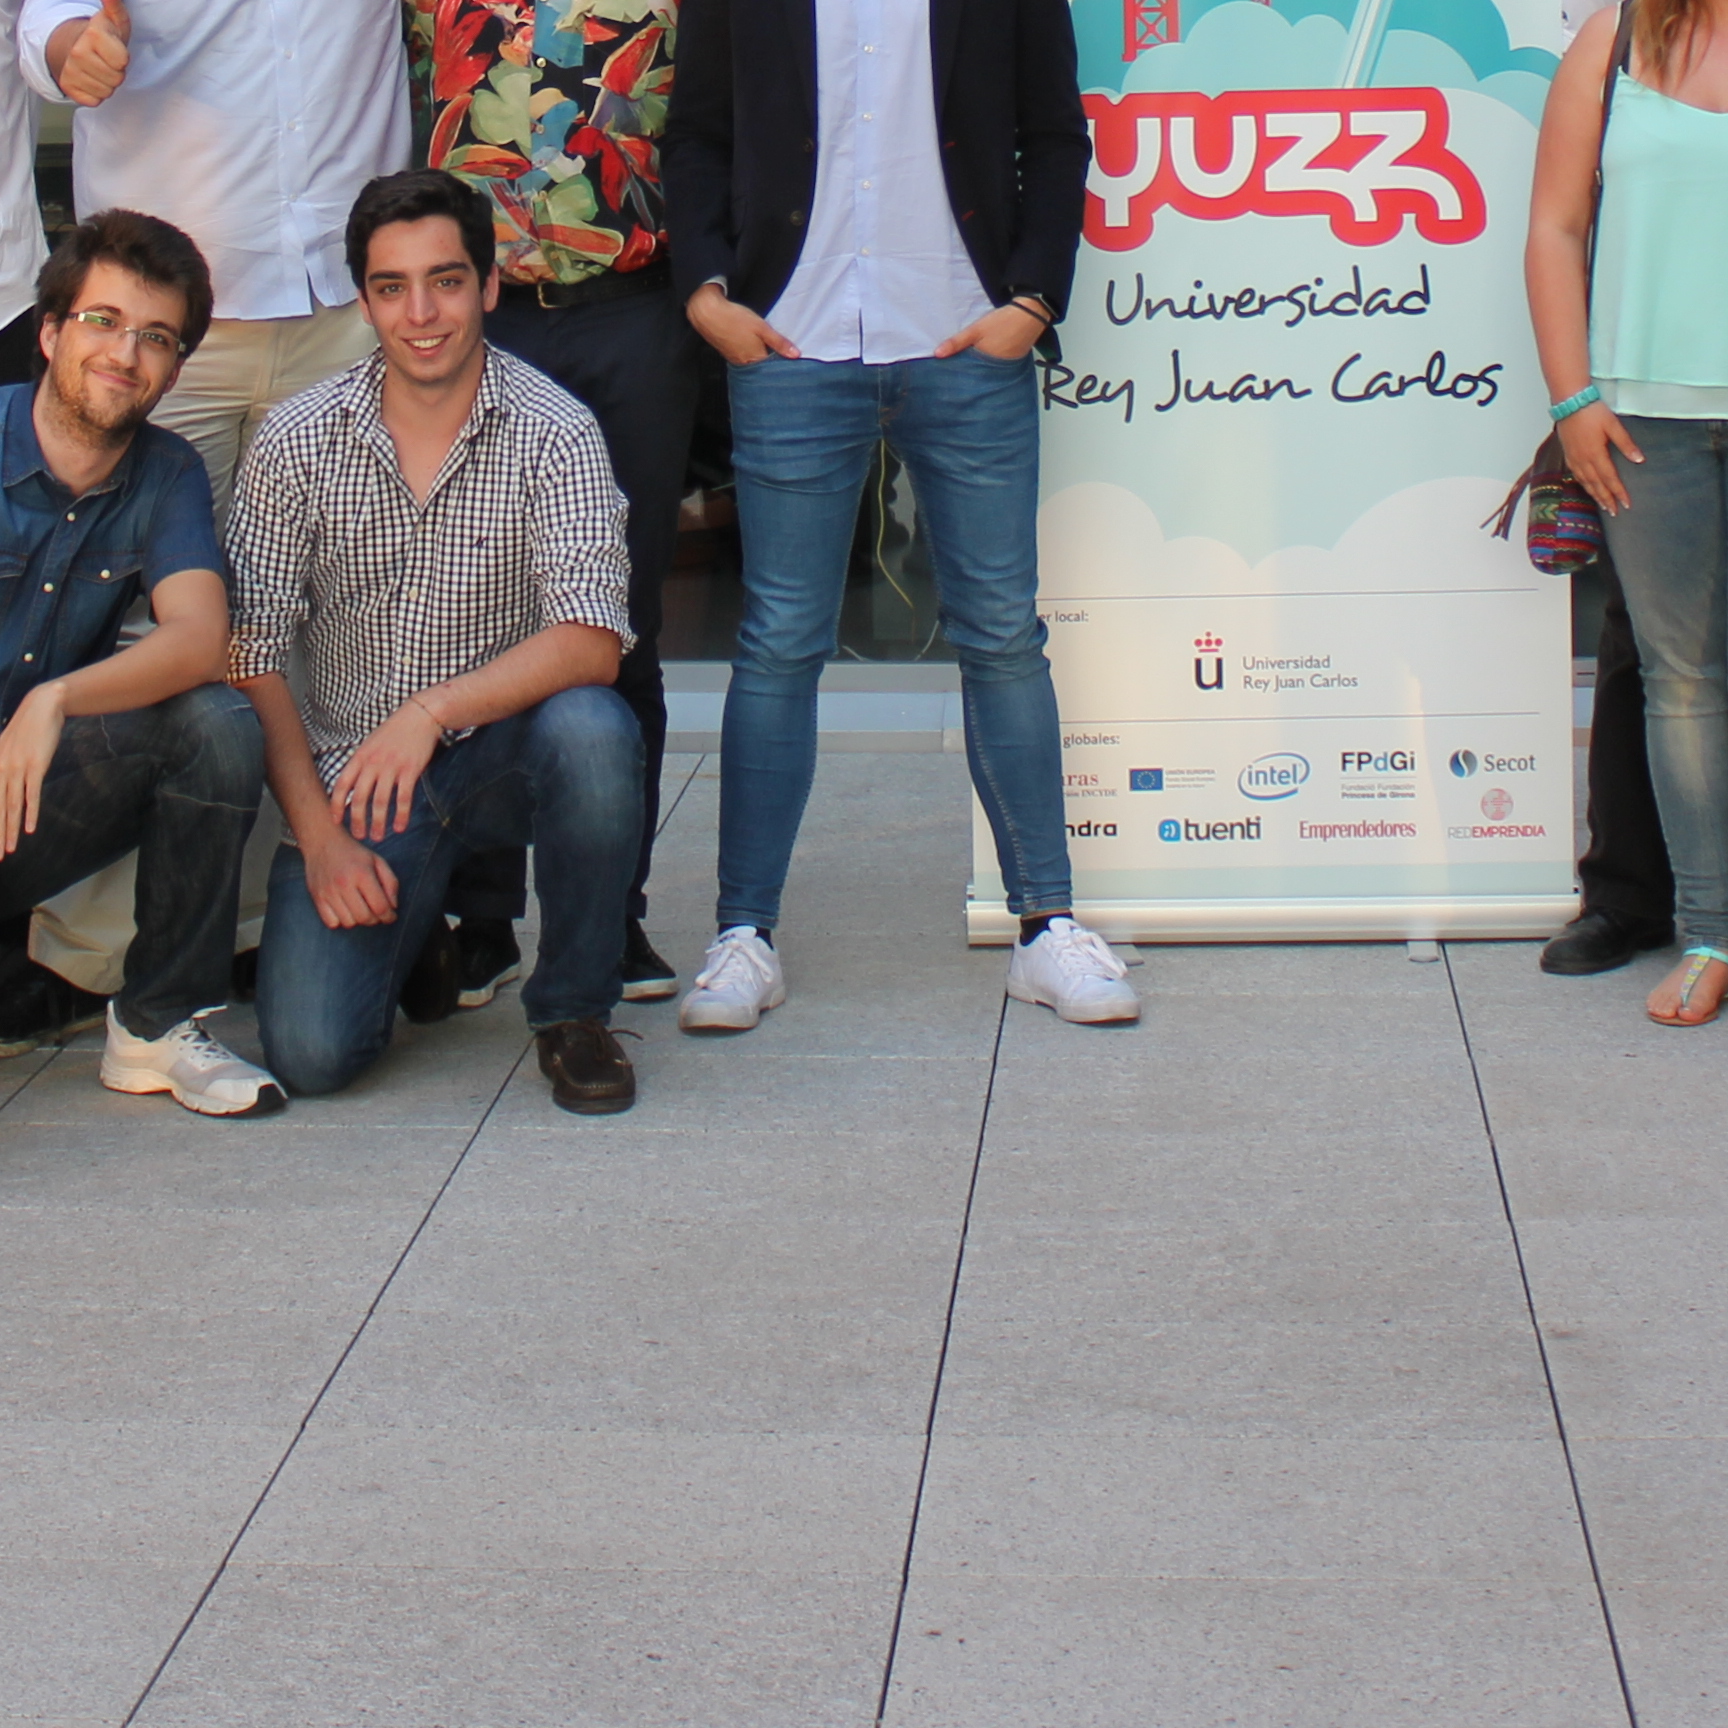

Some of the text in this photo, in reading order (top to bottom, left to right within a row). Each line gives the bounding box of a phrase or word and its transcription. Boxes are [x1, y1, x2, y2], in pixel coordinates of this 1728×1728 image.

[1107, 264, 1430, 327] Universidad
[1035, 349, 1503, 423] Rey Juan Carlos
[1055, 610, 1089, 623] local:
[1242, 655, 1330, 670] Universidad
[1243, 673, 1359, 693] Rey Juan Carlos
[1063, 733, 1120, 749] globales:
[1341, 751, 1415, 772] FPdGi
[1484, 754, 1536, 772] Secot
[1247, 763, 1299, 786] intel
[1065, 820, 1117, 837] ndra
[1184, 816, 1261, 841] tuenti
[1300, 820, 1416, 842] Emprendedores
[1448, 825, 1546, 839] REDEMPRENDIA
